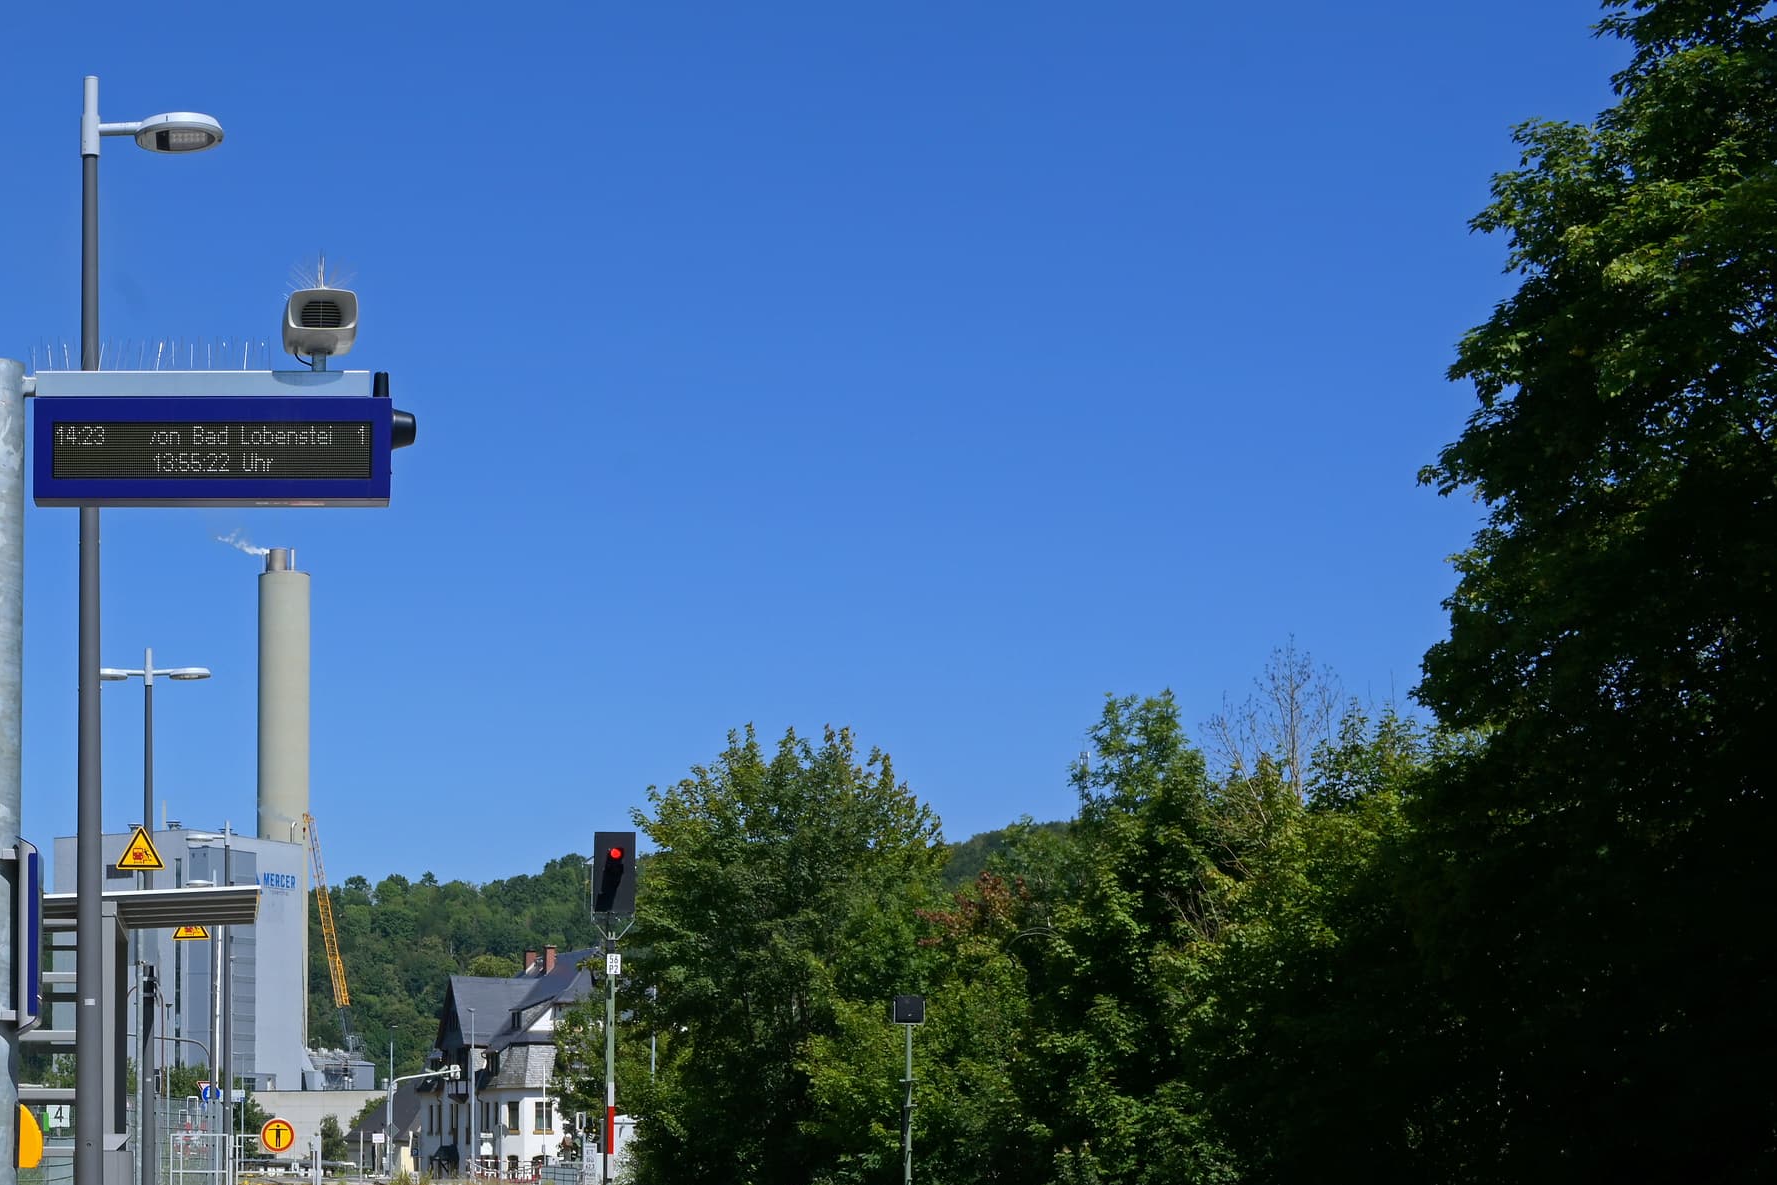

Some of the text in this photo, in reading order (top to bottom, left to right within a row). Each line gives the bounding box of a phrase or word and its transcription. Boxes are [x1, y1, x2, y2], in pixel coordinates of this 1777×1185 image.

[56, 425, 105, 446] 14:23
[193, 425, 229, 446] Bad
[357, 425, 365, 446] 1
[153, 452, 274, 472] 13:55:22 Uhr
[263, 871, 296, 889] MERCER
[54, 1104, 64, 1123] 4
